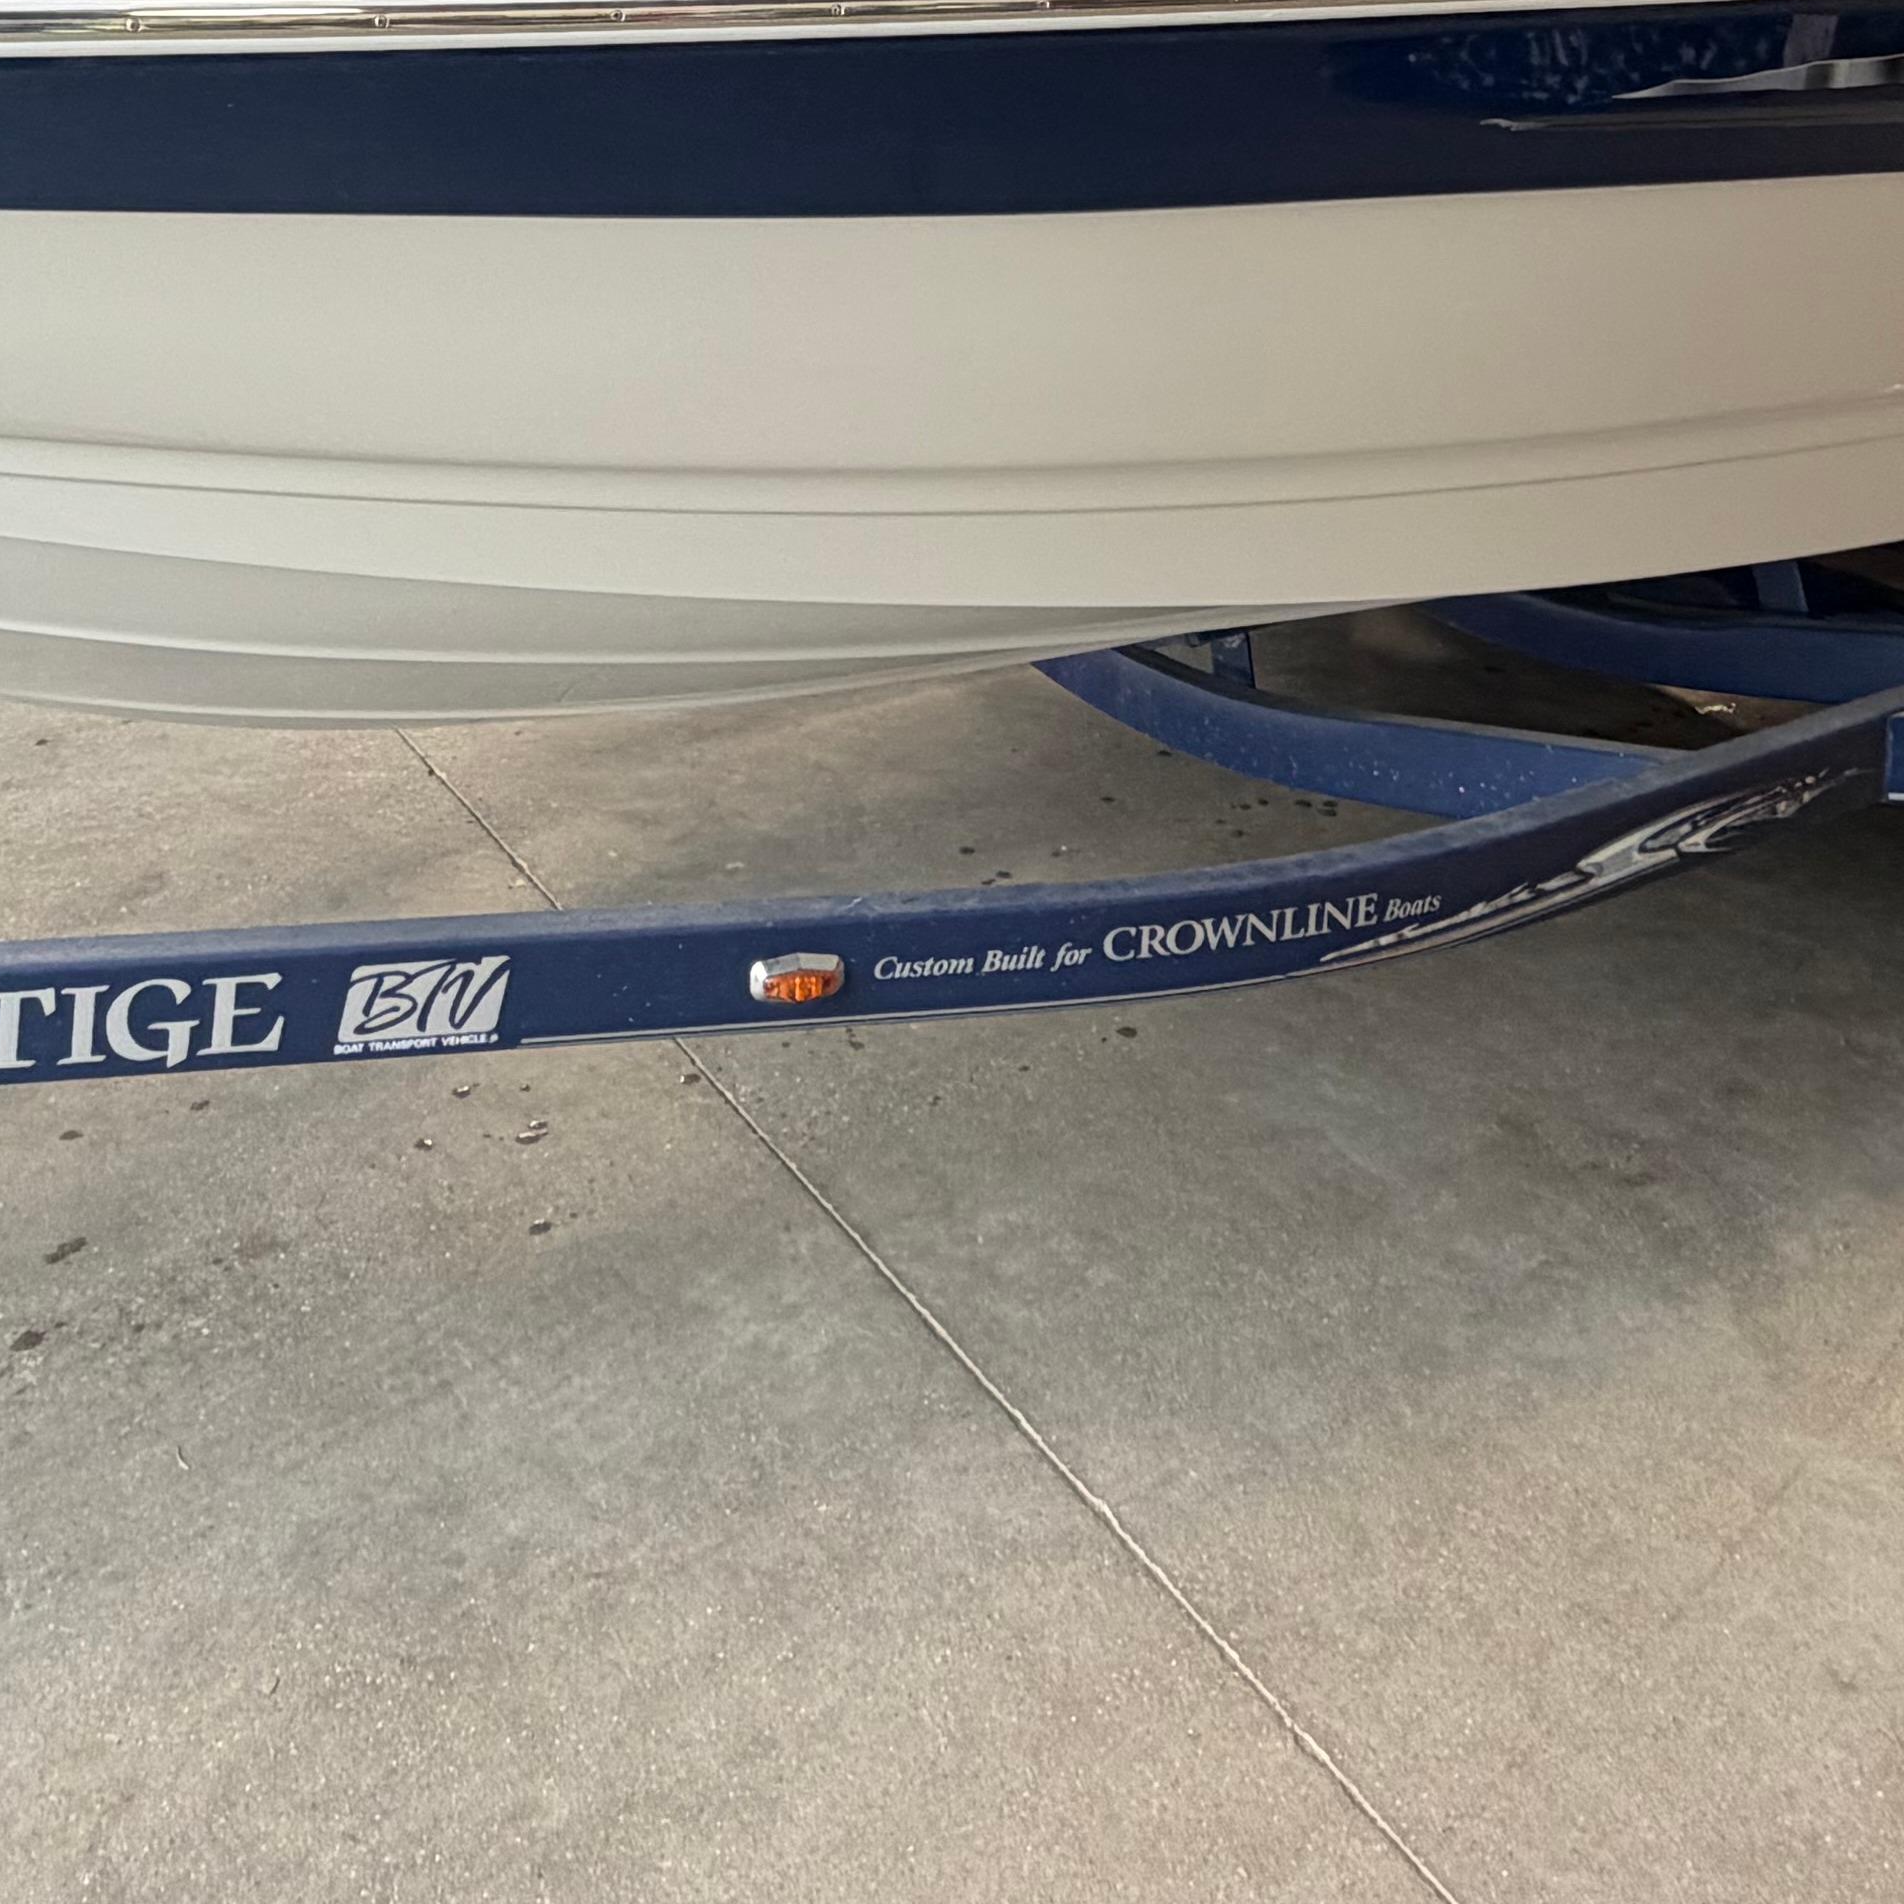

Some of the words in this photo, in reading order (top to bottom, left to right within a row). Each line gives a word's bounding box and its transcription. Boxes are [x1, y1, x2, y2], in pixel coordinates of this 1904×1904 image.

[873, 956, 974, 980] Custom
[981, 946, 1045, 974] Built
[1050, 943, 1092, 972] for
[1102, 893, 1379, 962] CROWNLINE
[1384, 894, 1442, 922] Boats
[333, 1043, 365, 1055] BOAT
[368, 1037, 437, 1052] TRANSPORT
[441, 1034, 486, 1046] VEHICLE
